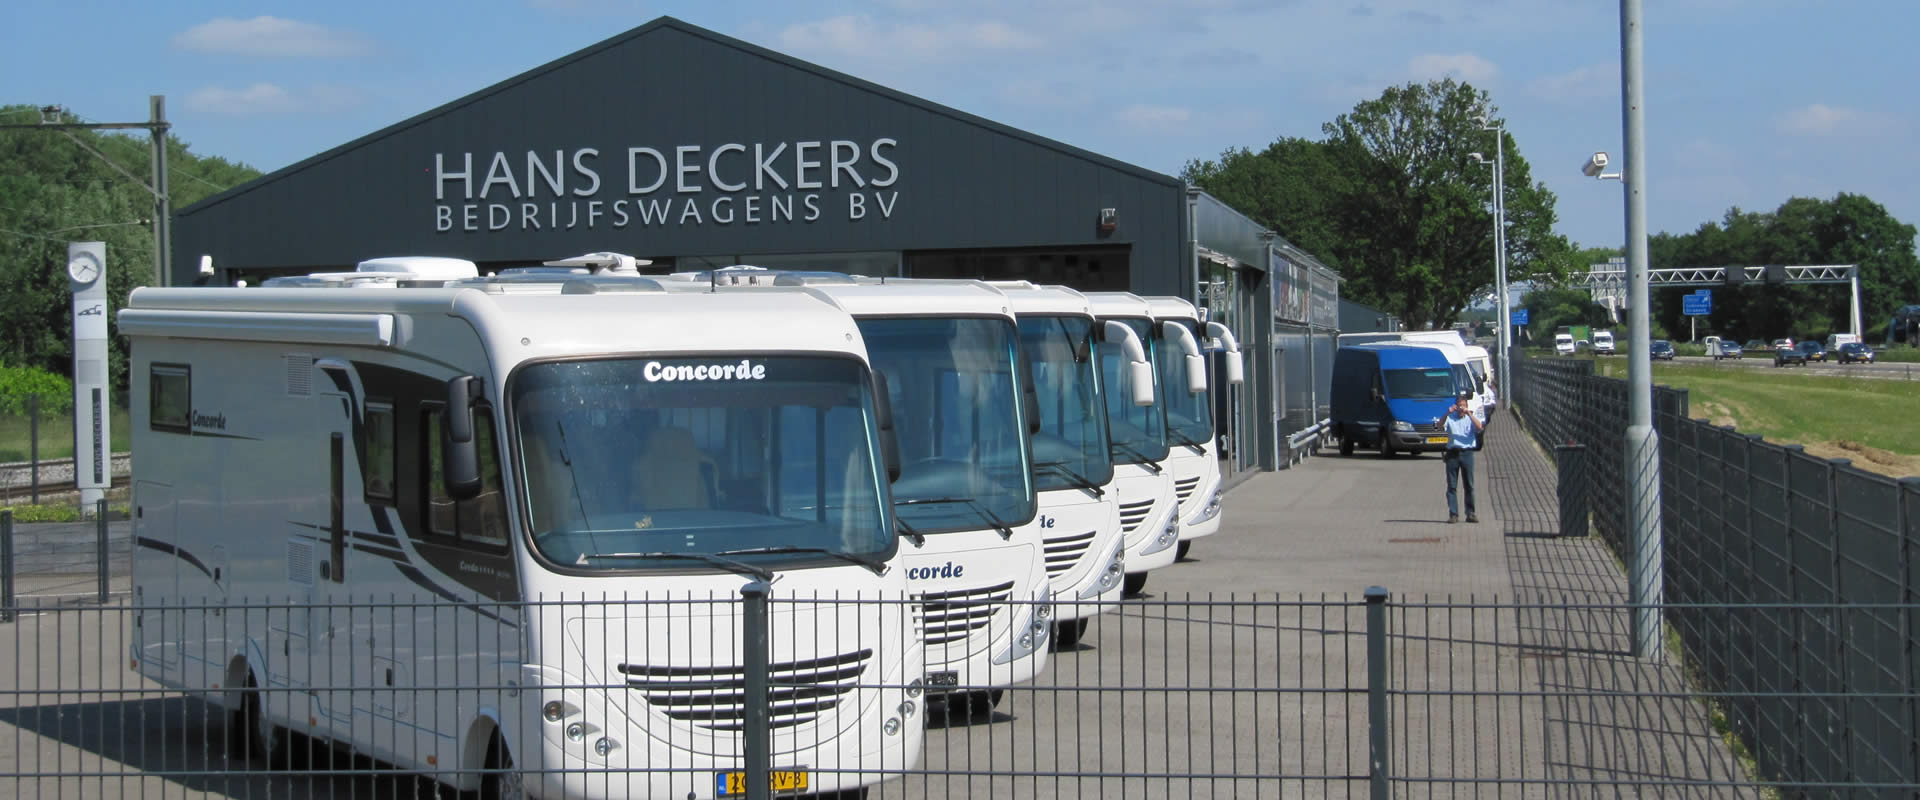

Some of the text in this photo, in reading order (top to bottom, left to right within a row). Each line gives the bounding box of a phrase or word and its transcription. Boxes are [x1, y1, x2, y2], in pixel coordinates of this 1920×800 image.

[435, 138, 898, 199] HANS DECKERS
[436, 191, 898, 231] BEDRIJFSWAGENS BV
[644, 360, 766, 382] Concorde
[192, 409, 226, 429] Concorde
[905, 562, 963, 580] corde
